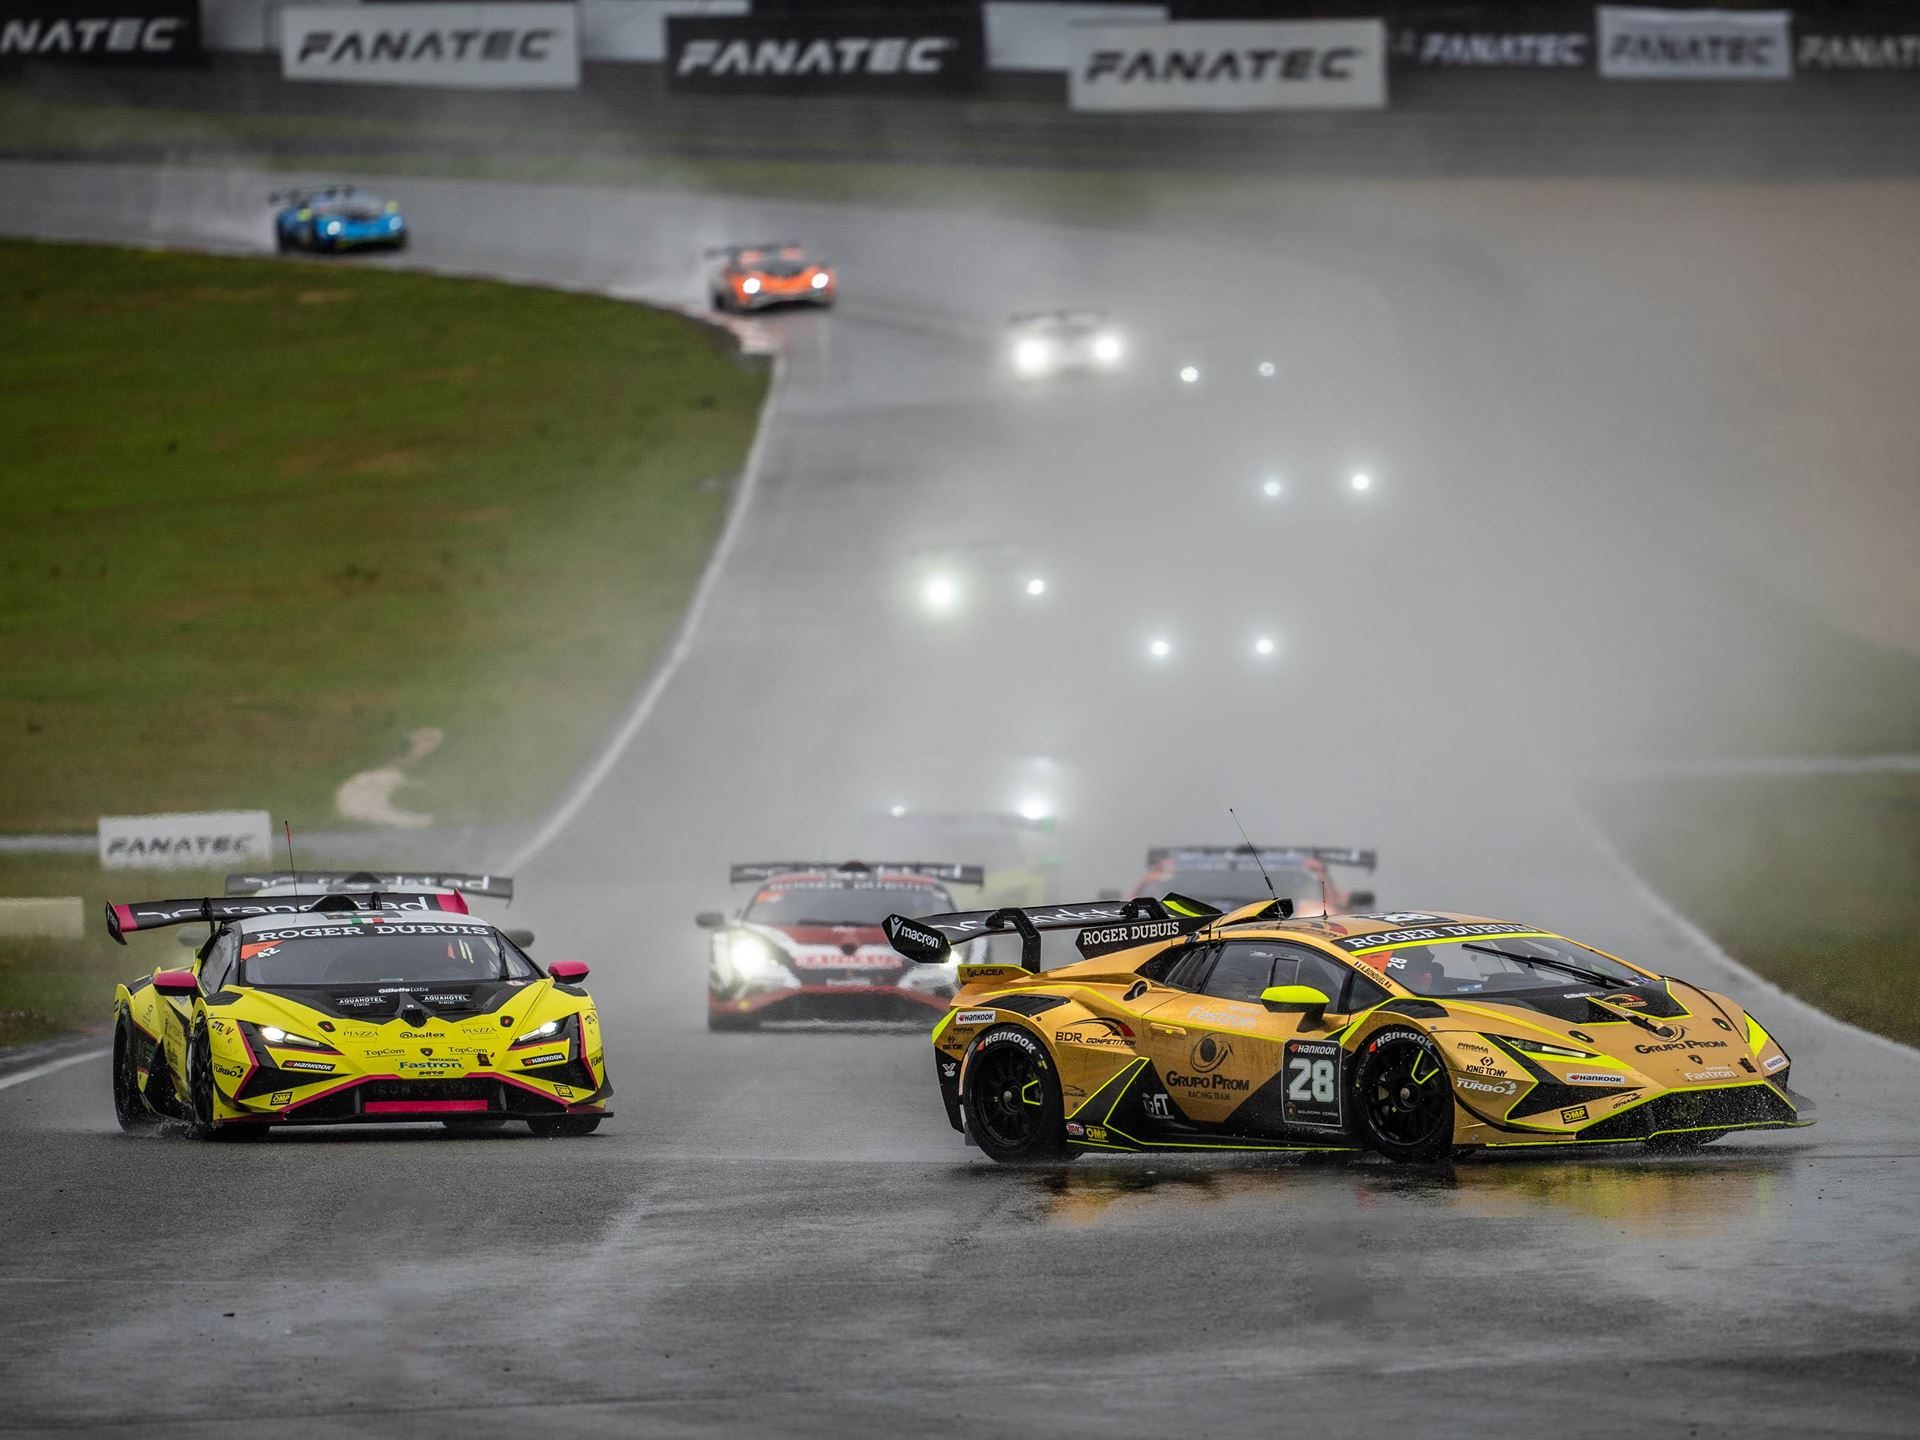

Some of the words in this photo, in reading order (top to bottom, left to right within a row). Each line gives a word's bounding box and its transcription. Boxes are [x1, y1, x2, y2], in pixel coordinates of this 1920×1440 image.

[1, 18, 182, 52] NATEC
[299, 28, 558, 65] FANATEC
[1421, 32, 1588, 67] FANATEC
[1607, 33, 1777, 67] FANATEC
[677, 36, 955, 75] FANATEC
[1084, 48, 1361, 86] FANATEC
[108, 833, 256, 856] FANATEC
[256, 924, 364, 942] ROGER
[376, 923, 490, 937] DUBUIS
[901, 925, 940, 950] macron
[1083, 928, 1129, 946] ROGER
[1131, 922, 1180, 941] DUBUIS
[1343, 926, 1445, 949] ROGER
[1445, 922, 1536, 937] DUBUIS
[256, 945, 281, 959] 42
[1386, 956, 1408, 970] 28
[462, 1027, 498, 1035] PIAZZA
[1055, 1031, 1083, 1044] BDR
[1085, 1036, 1137, 1047] COMPETITION
[1687, 1039, 1728, 1049] PROM
[364, 1048, 406, 1057] TopCom
[448, 1046, 488, 1055] TopCom
[1457, 1042, 1489, 1053] PRISMA
[213, 1064, 238, 1079] TURBO
[399, 1061, 463, 1070] Fastron
[1466, 1063, 1485, 1075] KING
[1485, 1067, 1509, 1078] TONY
[1166, 1070, 1211, 1090] GRUPO
[1211, 1073, 1250, 1091] PROM
[1288, 1057, 1335, 1103] 28
[1684, 1069, 1737, 1081] Fastron
[1456, 1079, 1507, 1095] TURBO
[272, 1094, 291, 1105] OMP
[1187, 1090, 1214, 1099] RACING
[1215, 1092, 1231, 1101] TEAM
[1564, 1109, 1586, 1121] OMP
[1086, 1126, 1108, 1140] OMP
